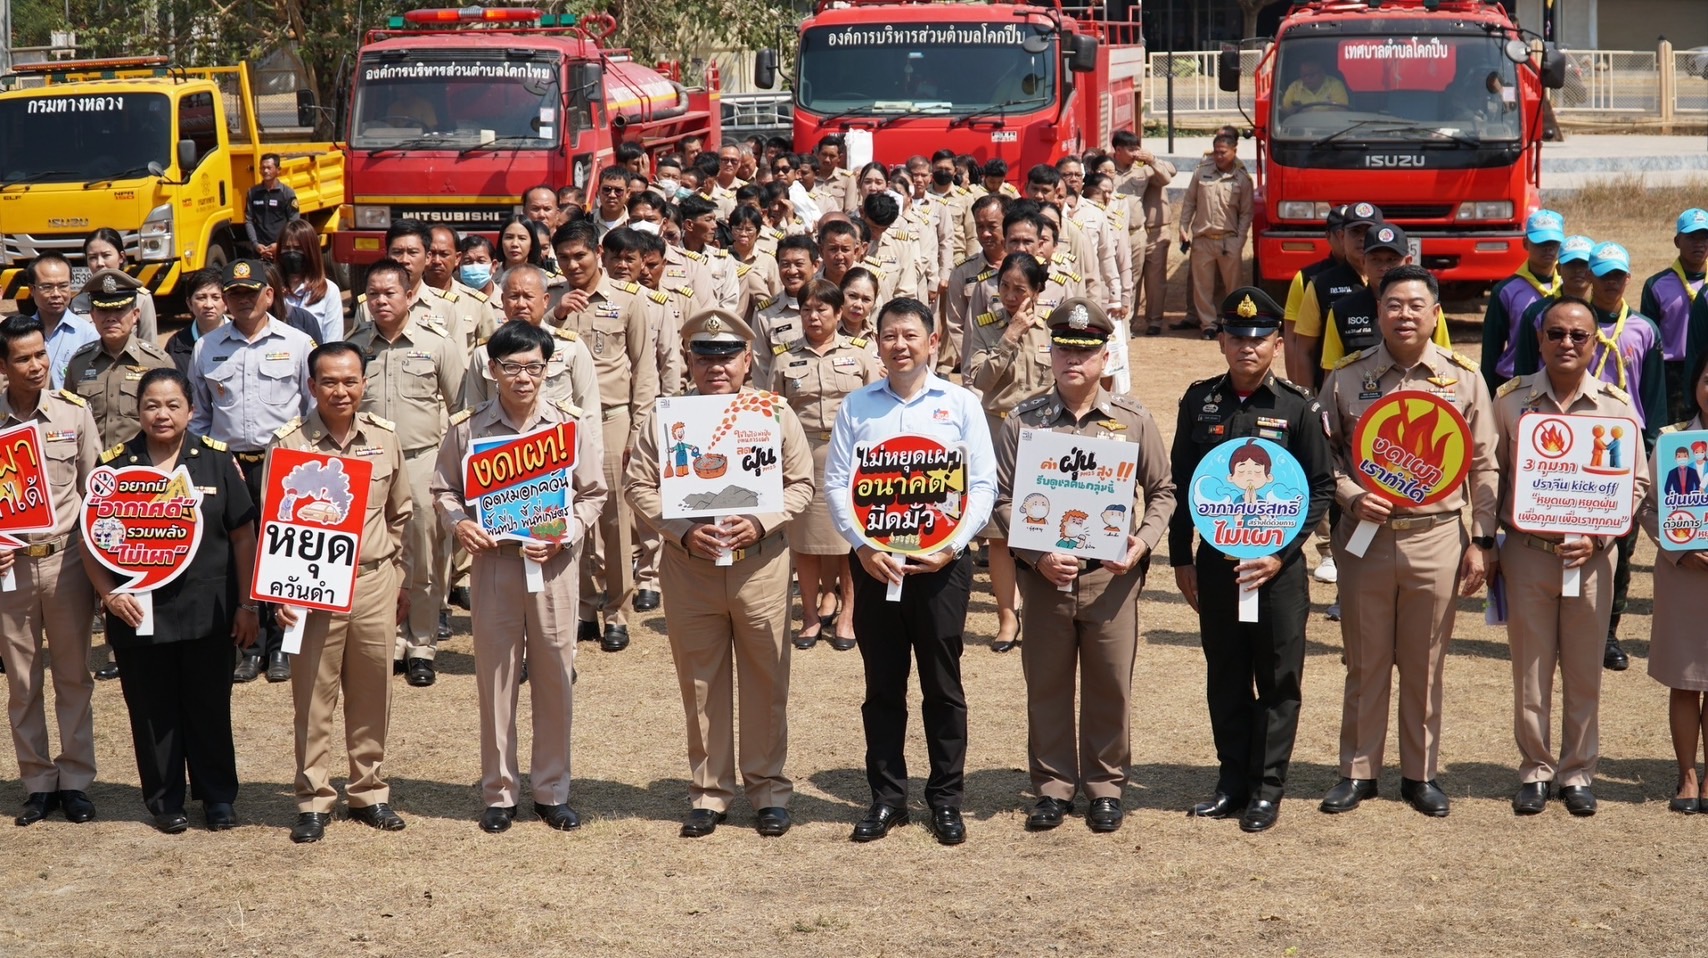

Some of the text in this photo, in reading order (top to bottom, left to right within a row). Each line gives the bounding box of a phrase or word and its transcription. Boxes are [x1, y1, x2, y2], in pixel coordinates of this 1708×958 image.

[828, 23, 1026, 46] องค์การบริหารส่วนตำบลโคกปีบ
[1344, 37, 1448, 59] เทศบาลตำบลโคกปีบ
[366, 61, 550, 80] องค์การบริหารส่วนตำบลโคกไทย
[27, 96, 124, 114] กรมทางหลวง
[1365, 155, 1425, 167] ISUZU
[48, 218, 89, 227] ISUZU
[402, 211, 500, 221] MITSUBISHI
[1348, 316, 1369, 325] ISOC
[472, 423, 568, 487] งดเผา!
[857, 444, 962, 473] ไม่หยุดเผา
[1372, 437, 1443, 486] งดเผา
[1522, 459, 1577, 476] 3 กุมภา
[119, 478, 167, 493] อยากมี
[482, 470, 569, 511] ลดหมอกควัน
[857, 475, 947, 497] อนาคต
[1360, 459, 1430, 503] เราทำได้
[1532, 478, 1619, 495] ปราจีน kick off
[1199, 495, 1303, 519] อากาศบริสุทธิ์
[126, 524, 187, 540] รวมพลัง
[1214, 520, 1284, 546] ไม่เผา
[266, 524, 355, 579] หยุด
[270, 575, 335, 604] ควันดำ
